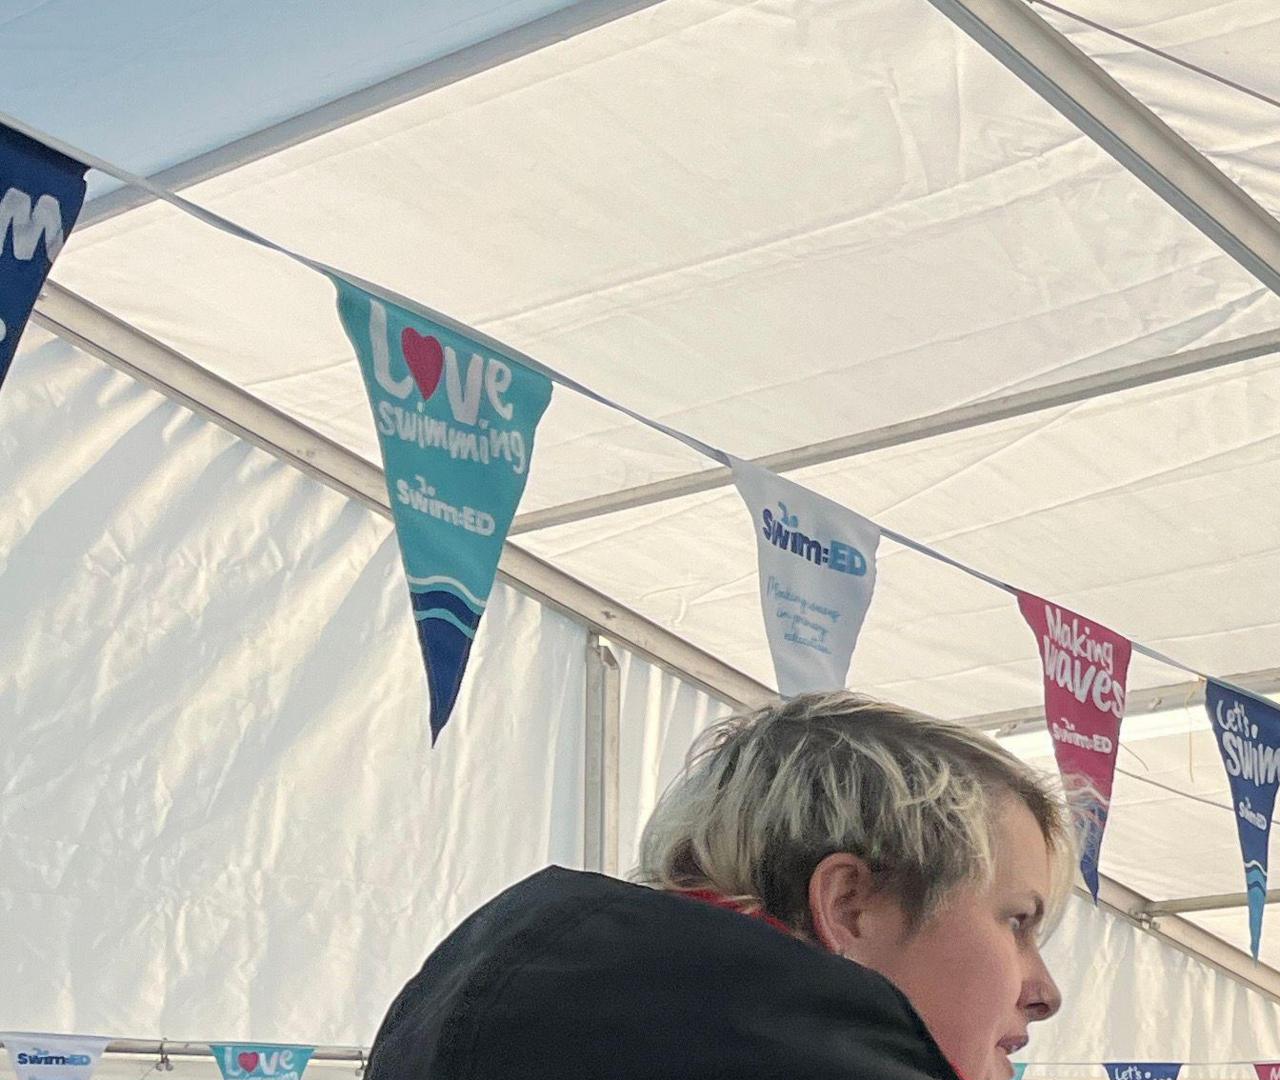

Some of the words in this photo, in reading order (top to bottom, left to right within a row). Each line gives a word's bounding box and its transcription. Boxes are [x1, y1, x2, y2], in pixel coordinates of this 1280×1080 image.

[378, 401, 527, 474] swimming
[762, 508, 867, 577] Swim:ED
[1045, 604, 1113, 672] Making
[1043, 635, 1125, 719] waves
[1115, 1067, 1142, 1080] Let's
